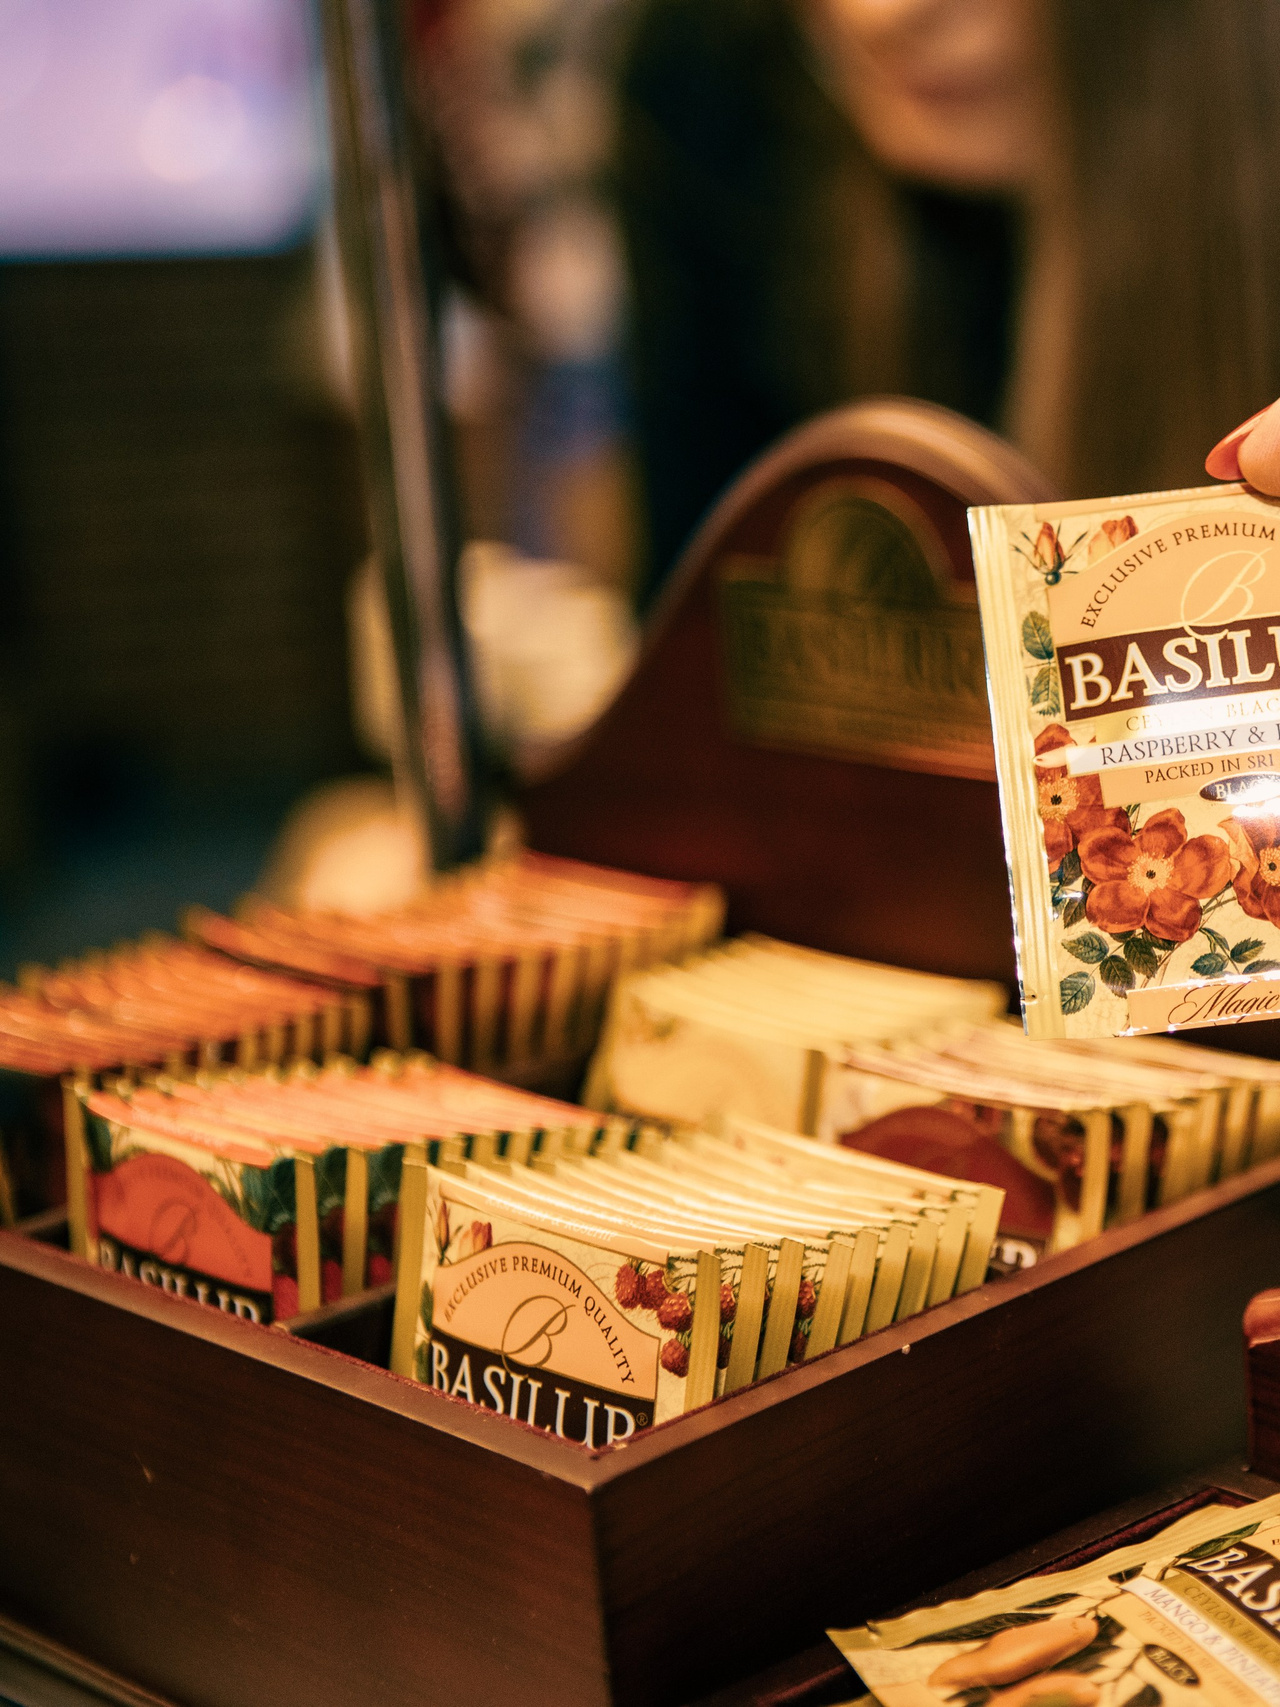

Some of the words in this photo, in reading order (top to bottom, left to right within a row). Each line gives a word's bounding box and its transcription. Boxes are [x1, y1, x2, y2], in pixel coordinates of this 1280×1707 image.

[1080, 538, 1168, 629] EXCLUSIVE
[1171, 522, 1276, 547] PREMIUM
[1100, 728, 1238, 767] RASPBERRY
[1247, 725, 1267, 745] &
[1144, 761, 1215, 784] PACKED
[1221, 756, 1241, 773] IN
[1247, 753, 1275, 771] SRI
[1167, 980, 1280, 1025] Magic
[443, 1256, 509, 1324] EXCLUSIVE
[512, 1255, 583, 1299] PREMIUM
[584, 1295, 636, 1386] QUALITY
[1143, 1588, 1211, 1635] MANGO
[1150, 1649, 1196, 1685] BLACK
